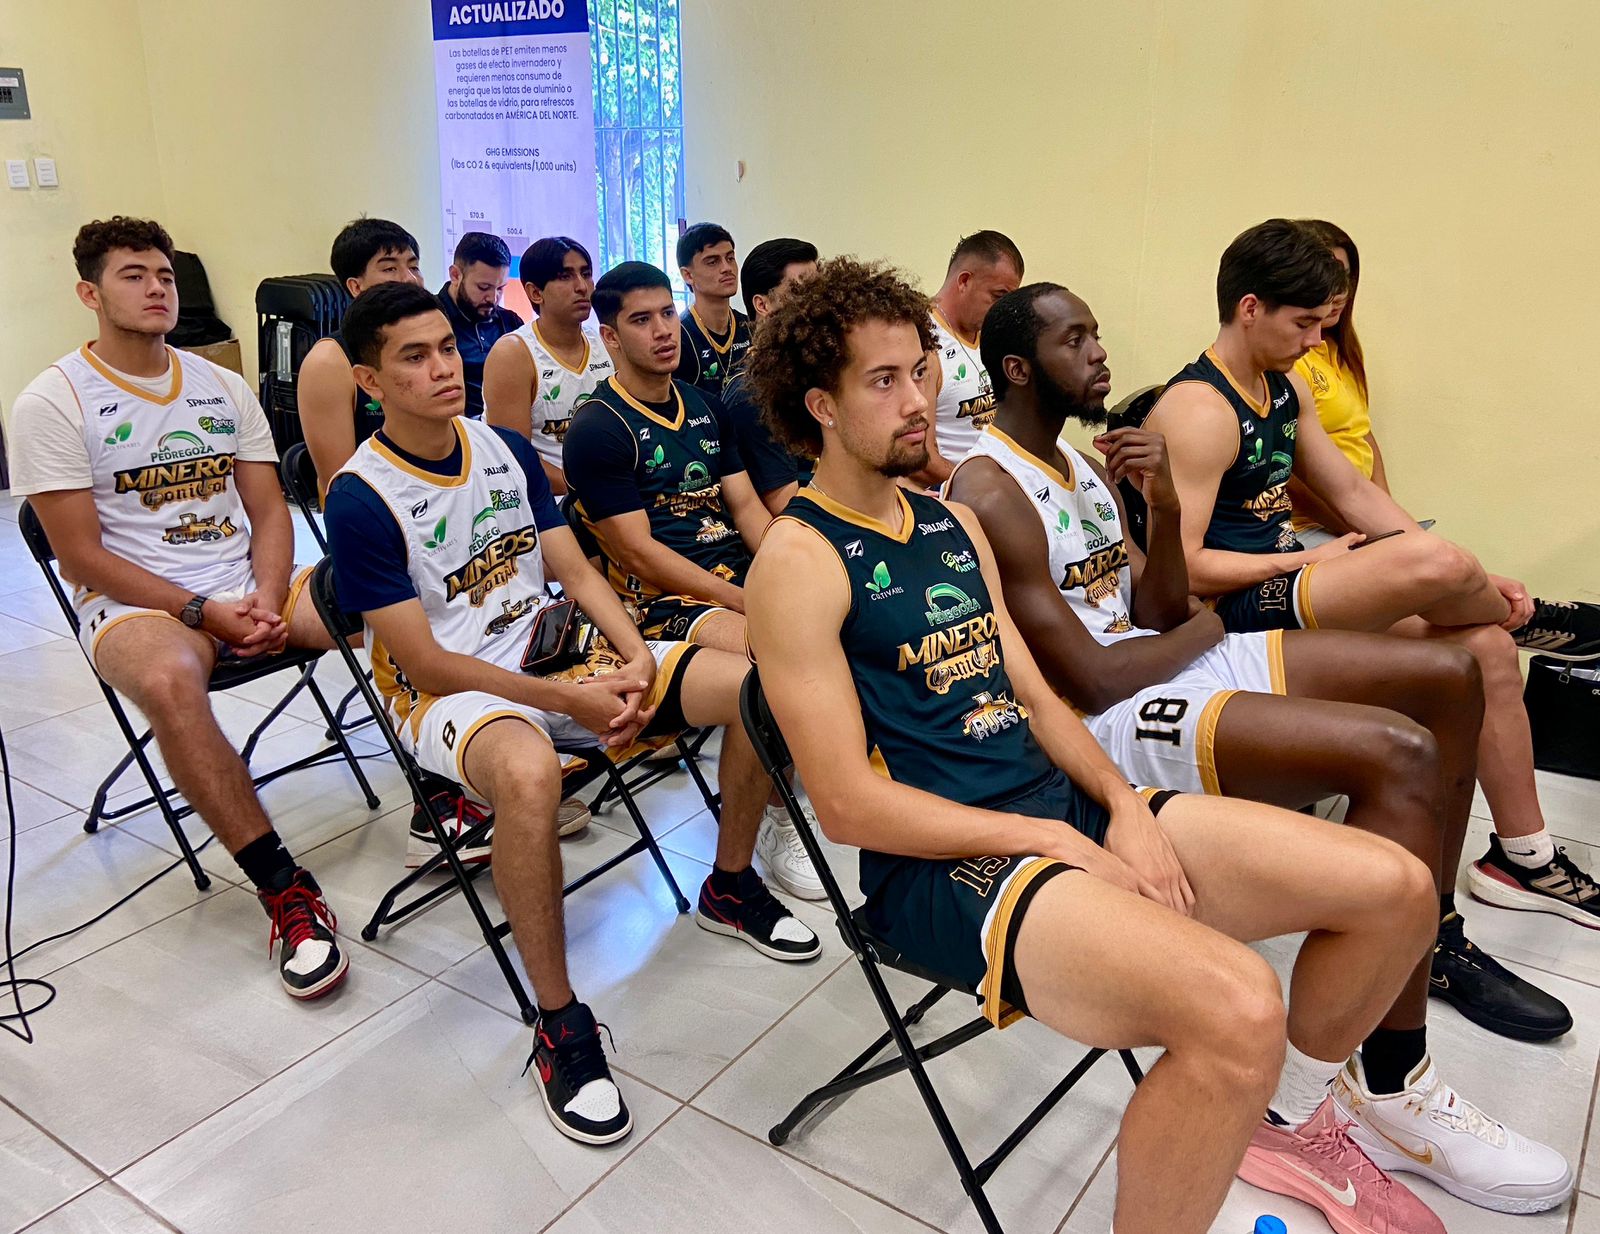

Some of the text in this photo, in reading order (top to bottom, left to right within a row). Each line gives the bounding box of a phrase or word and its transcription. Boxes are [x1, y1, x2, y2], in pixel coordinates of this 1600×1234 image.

[449, 0, 564, 25] ACTUALIZADO
[449, 45, 567, 58] Las botellas de PET emiten menos
[456, 58, 562, 72] gases de efecto invernadero y
[457, 71, 562, 83] requieren menos consumo de
[448, 86, 475, 98] energía
[477, 87, 490, 97] que
[491, 85, 500, 95] las
[502, 85, 520, 94] latas
[522, 85, 531, 94] de
[533, 84, 566, 94] aluminio
[448, 97, 574, 108] las botellas de vidrio, para refrescos
[445, 110, 494, 120] carbonatados
[505, 109, 538, 120] AMÉRICA
[540, 111, 551, 120] DEL
[552, 110, 579, 120] NORTE.
[486, 147, 540, 157] GHG EMISSIONS
[466, 160, 477, 169] CO
[479, 160, 483, 169] 2
[485, 160, 490, 170] &
[492, 159, 554, 172] equivalents/1,000
[555, 160, 577, 173] units)
[151, 445, 214, 462] PEDREGOZA
[115, 454, 236, 493] MINERO
[1259, 578, 1288, 611] 13
[896, 612, 999, 671] MINERO
[1136, 697, 1188, 747] 18
